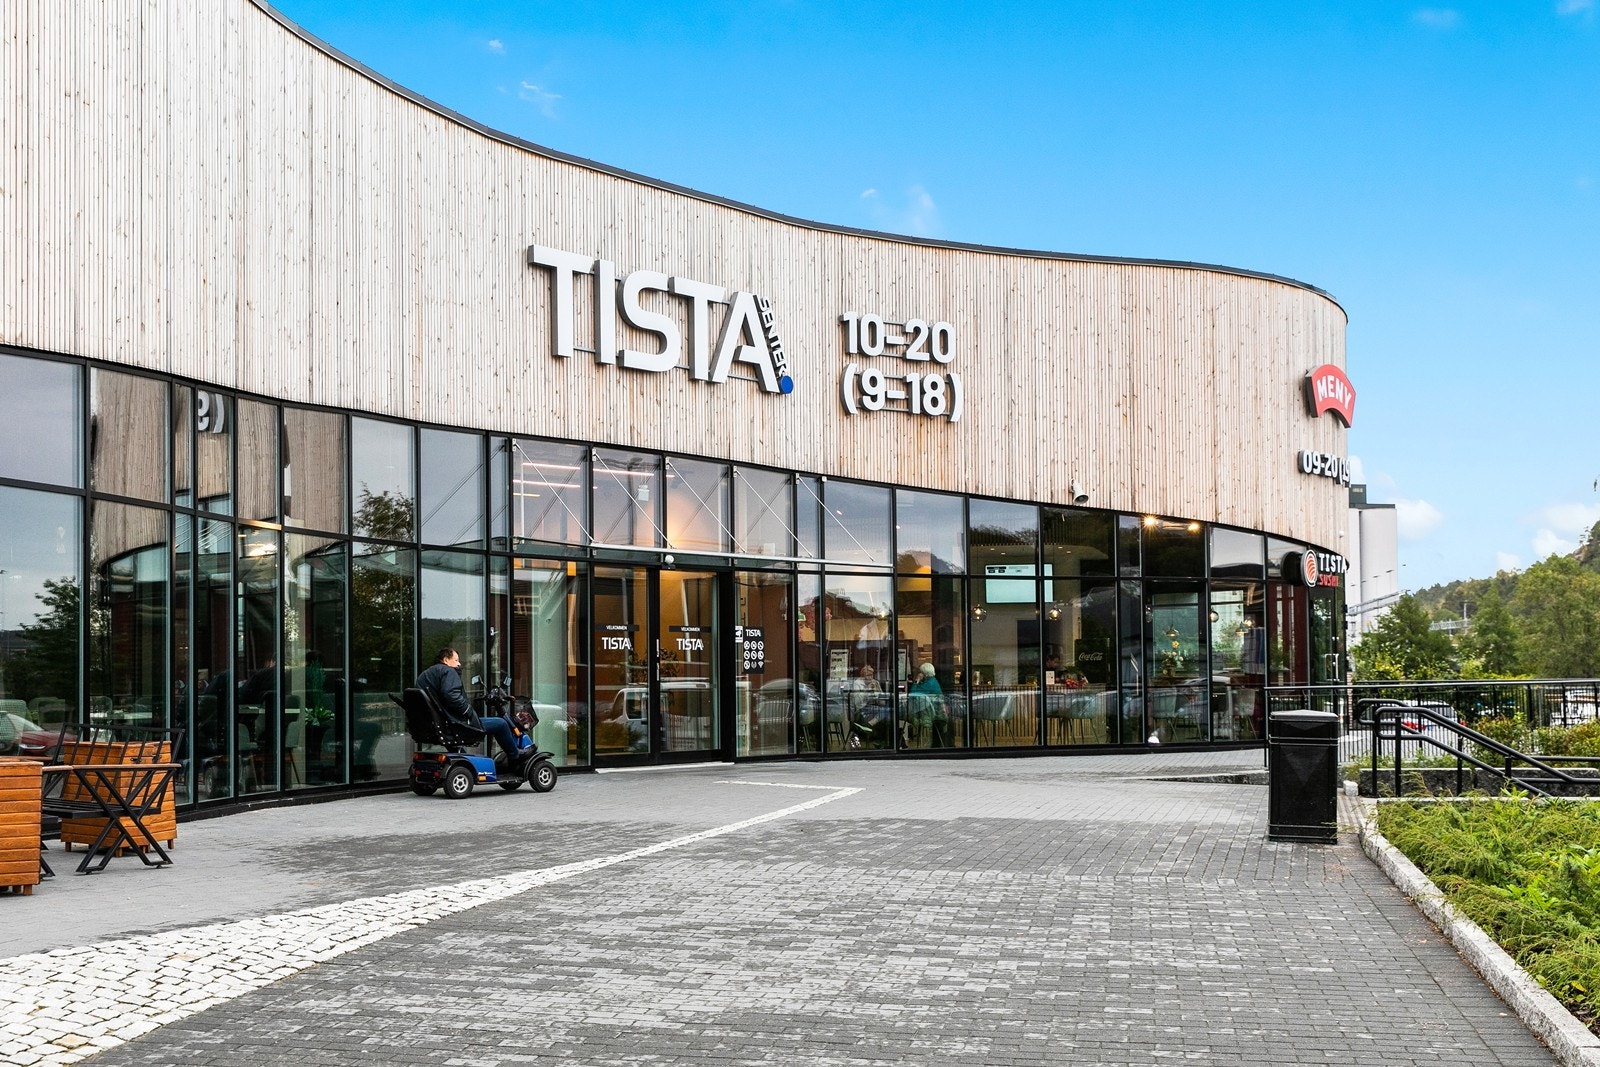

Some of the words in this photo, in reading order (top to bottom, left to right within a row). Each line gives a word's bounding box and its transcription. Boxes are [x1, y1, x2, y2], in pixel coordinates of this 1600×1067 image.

[529, 244, 781, 393] TISTA
[760, 295, 790, 378] SENTER
[841, 311, 957, 364] 10-20
[841, 362, 964, 422] (9-18)
[1316, 374, 1352, 410] MENY
[1301, 449, 1338, 478] 09-20
[1319, 553, 1347, 574] TISTA
[601, 637, 630, 650] TISTA
[676, 638, 703, 650] TISTA
[745, 629, 762, 637] TISTA
